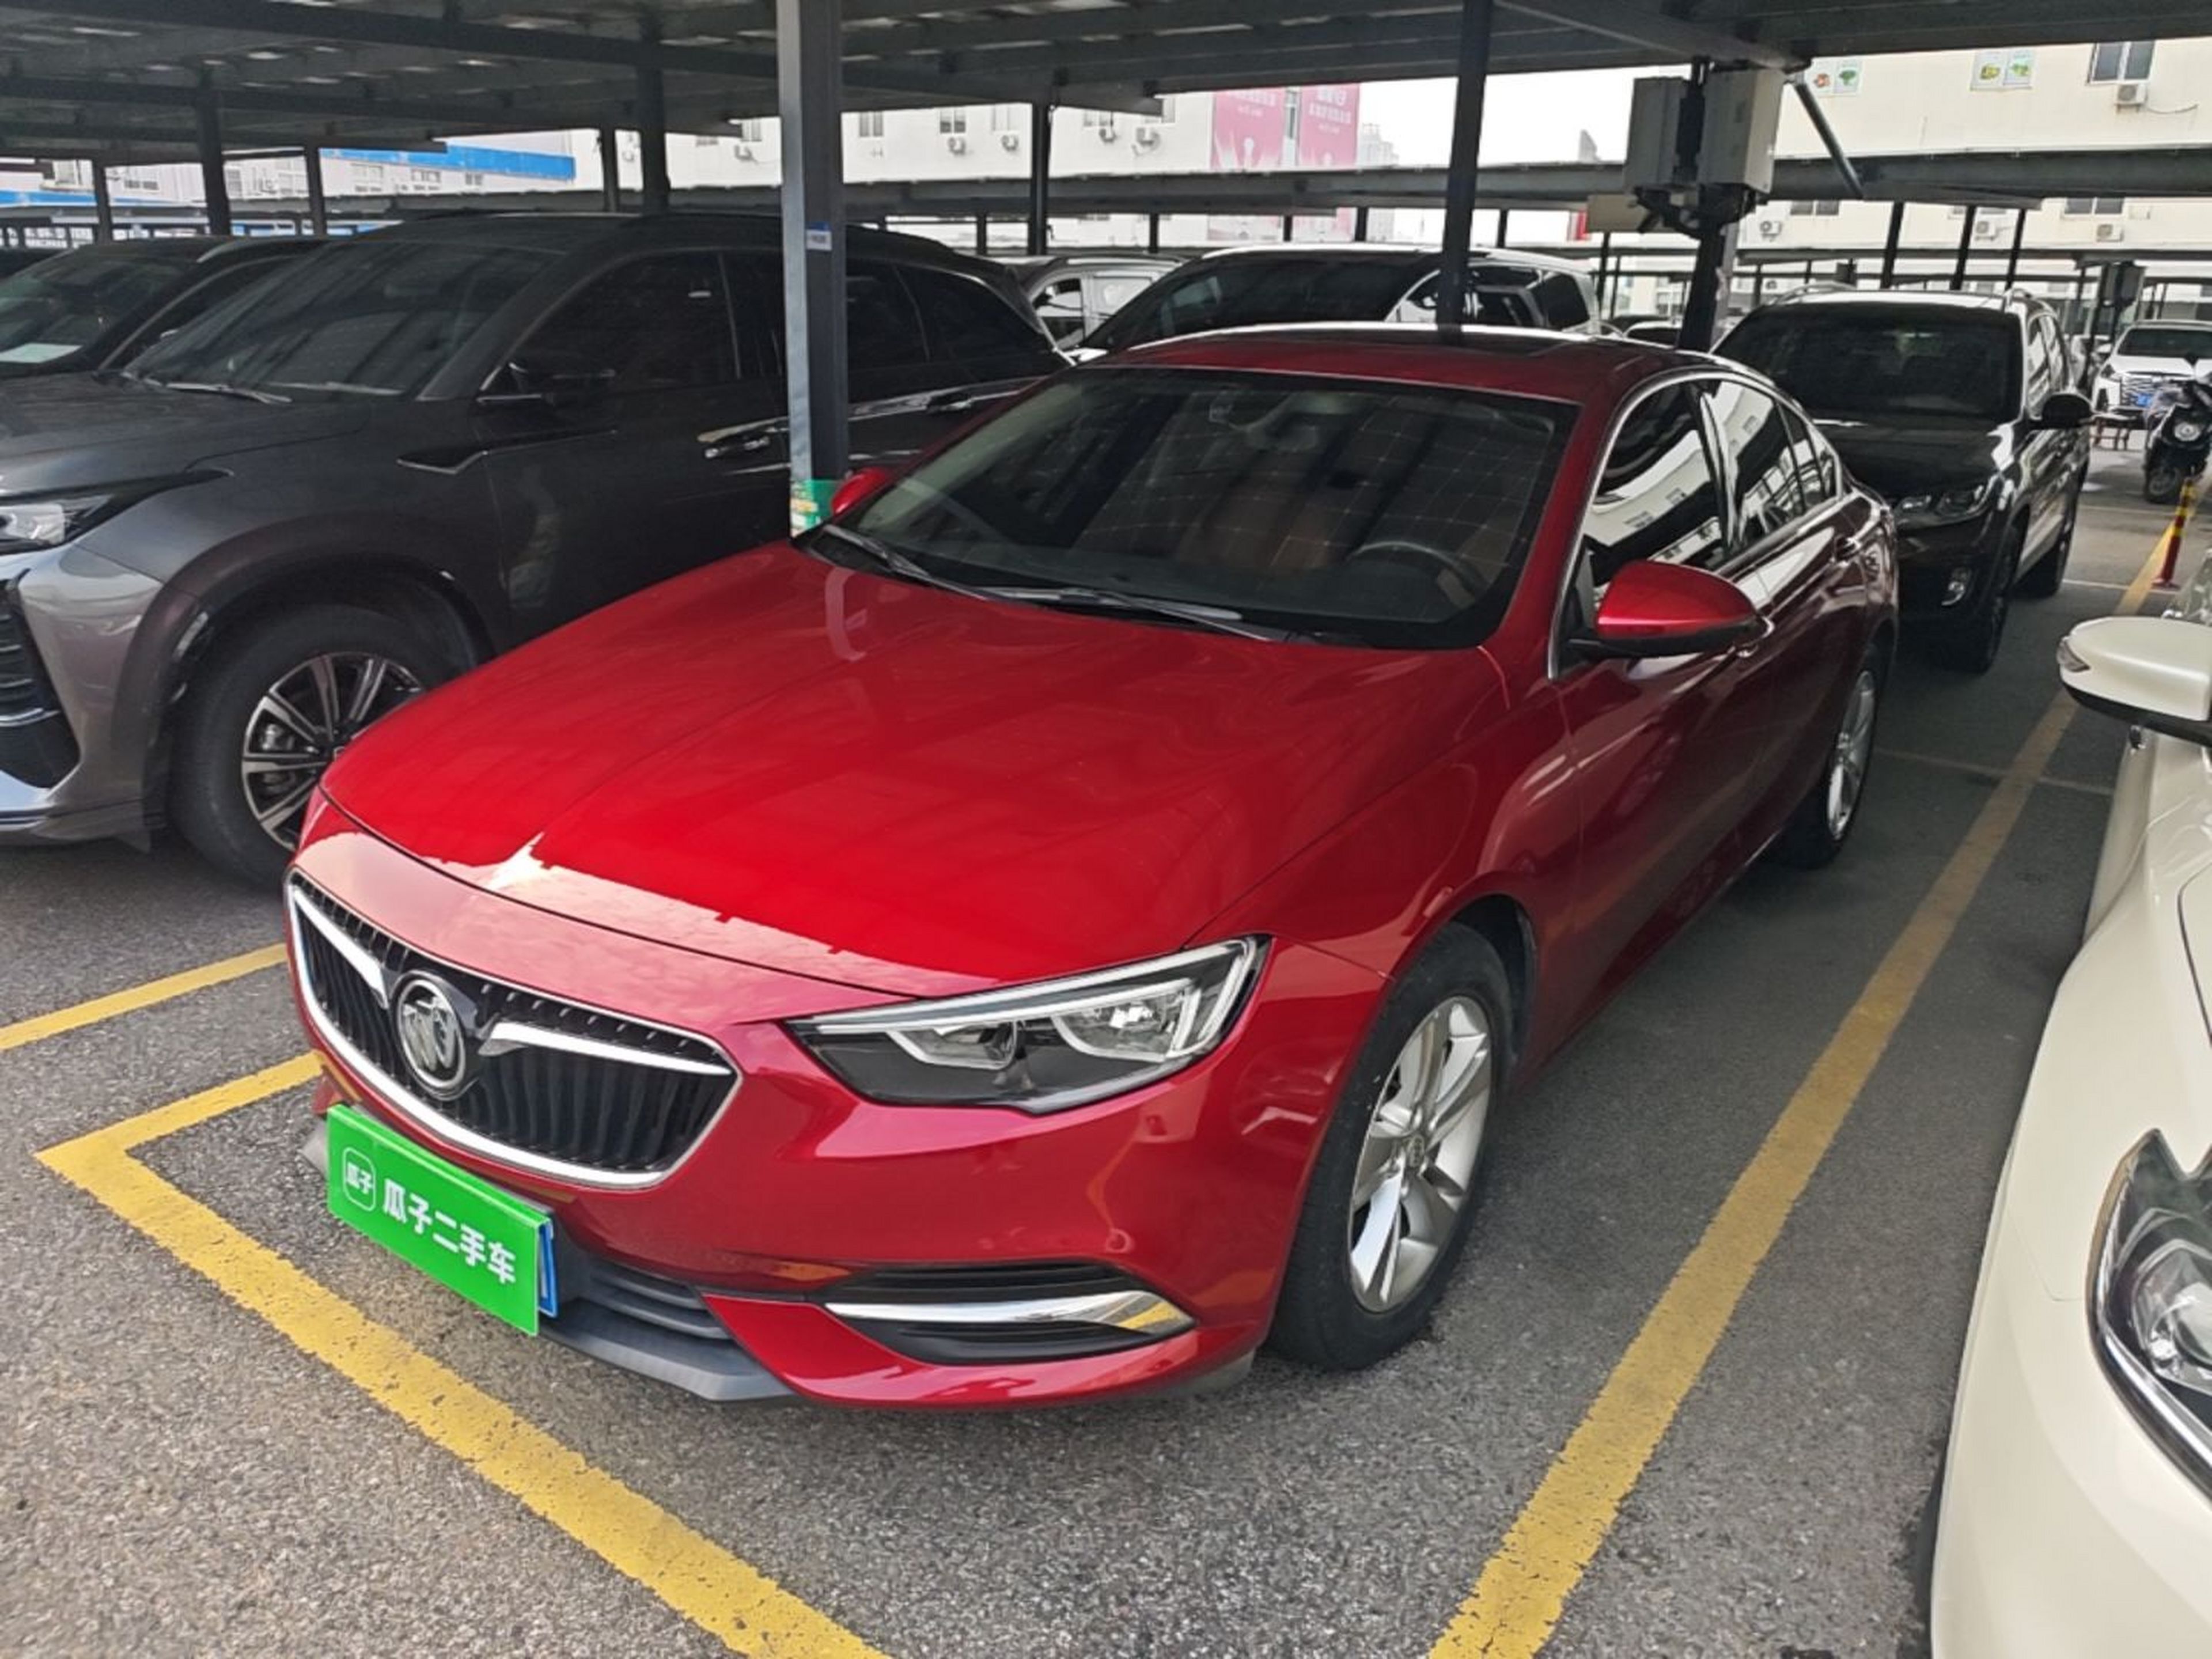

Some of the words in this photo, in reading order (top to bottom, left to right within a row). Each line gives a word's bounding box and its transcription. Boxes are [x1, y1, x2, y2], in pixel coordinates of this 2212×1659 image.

[383, 1178, 516, 1285] 瓜子二手车
